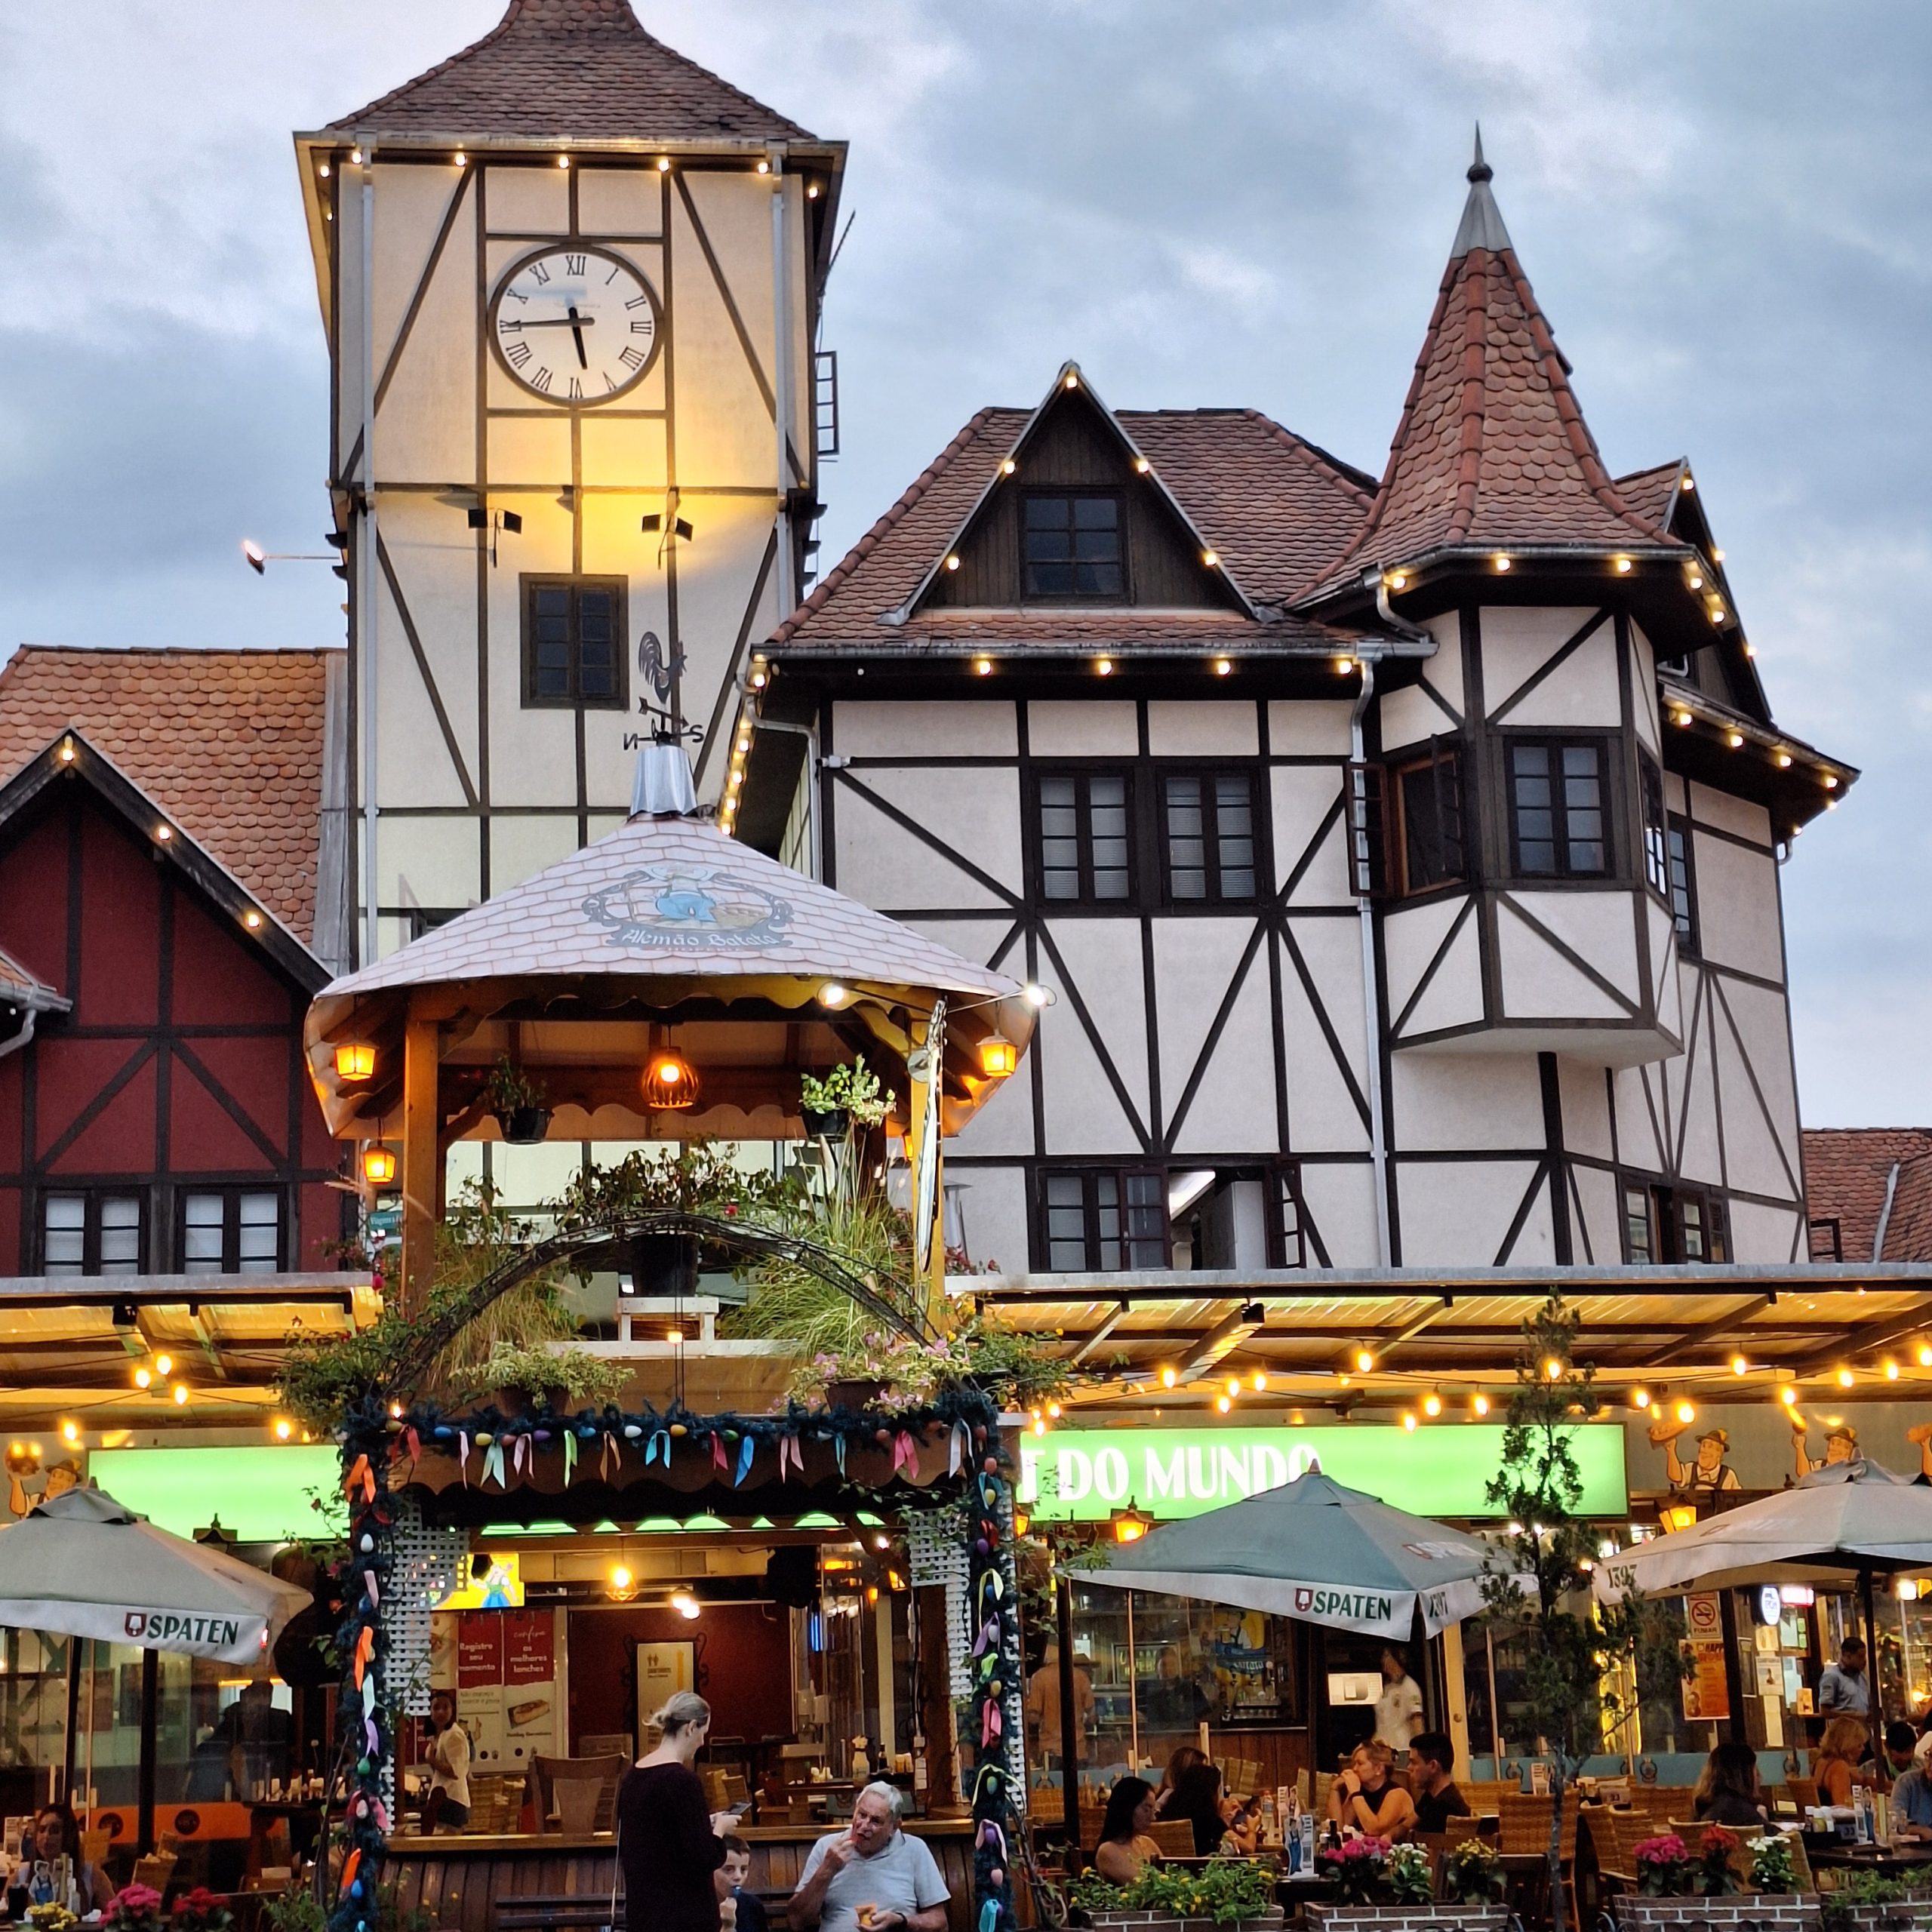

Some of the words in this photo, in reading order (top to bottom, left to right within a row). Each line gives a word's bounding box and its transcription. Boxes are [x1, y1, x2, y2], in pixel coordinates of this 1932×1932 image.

[529, 262, 551, 285] XI
[566, 255, 586, 275] XII
[605, 266, 620, 285] I
[506, 288, 528, 304] X
[624, 295, 647, 310] II
[630, 321, 652, 335] III
[506, 342, 533, 369] VIII
[531, 367, 553, 392] VII
[569, 377, 583, 398] VI
[602, 371, 617, 391] V
[690, 724, 704, 743] S
[622, 929, 700, 946] Alemão
[707, 934, 780, 946] Batata
[1057, 1447, 1129, 1500] DO
[1313, 1591, 1391, 1621] SPATEN
[147, 1614, 238, 1645] SPATEN
